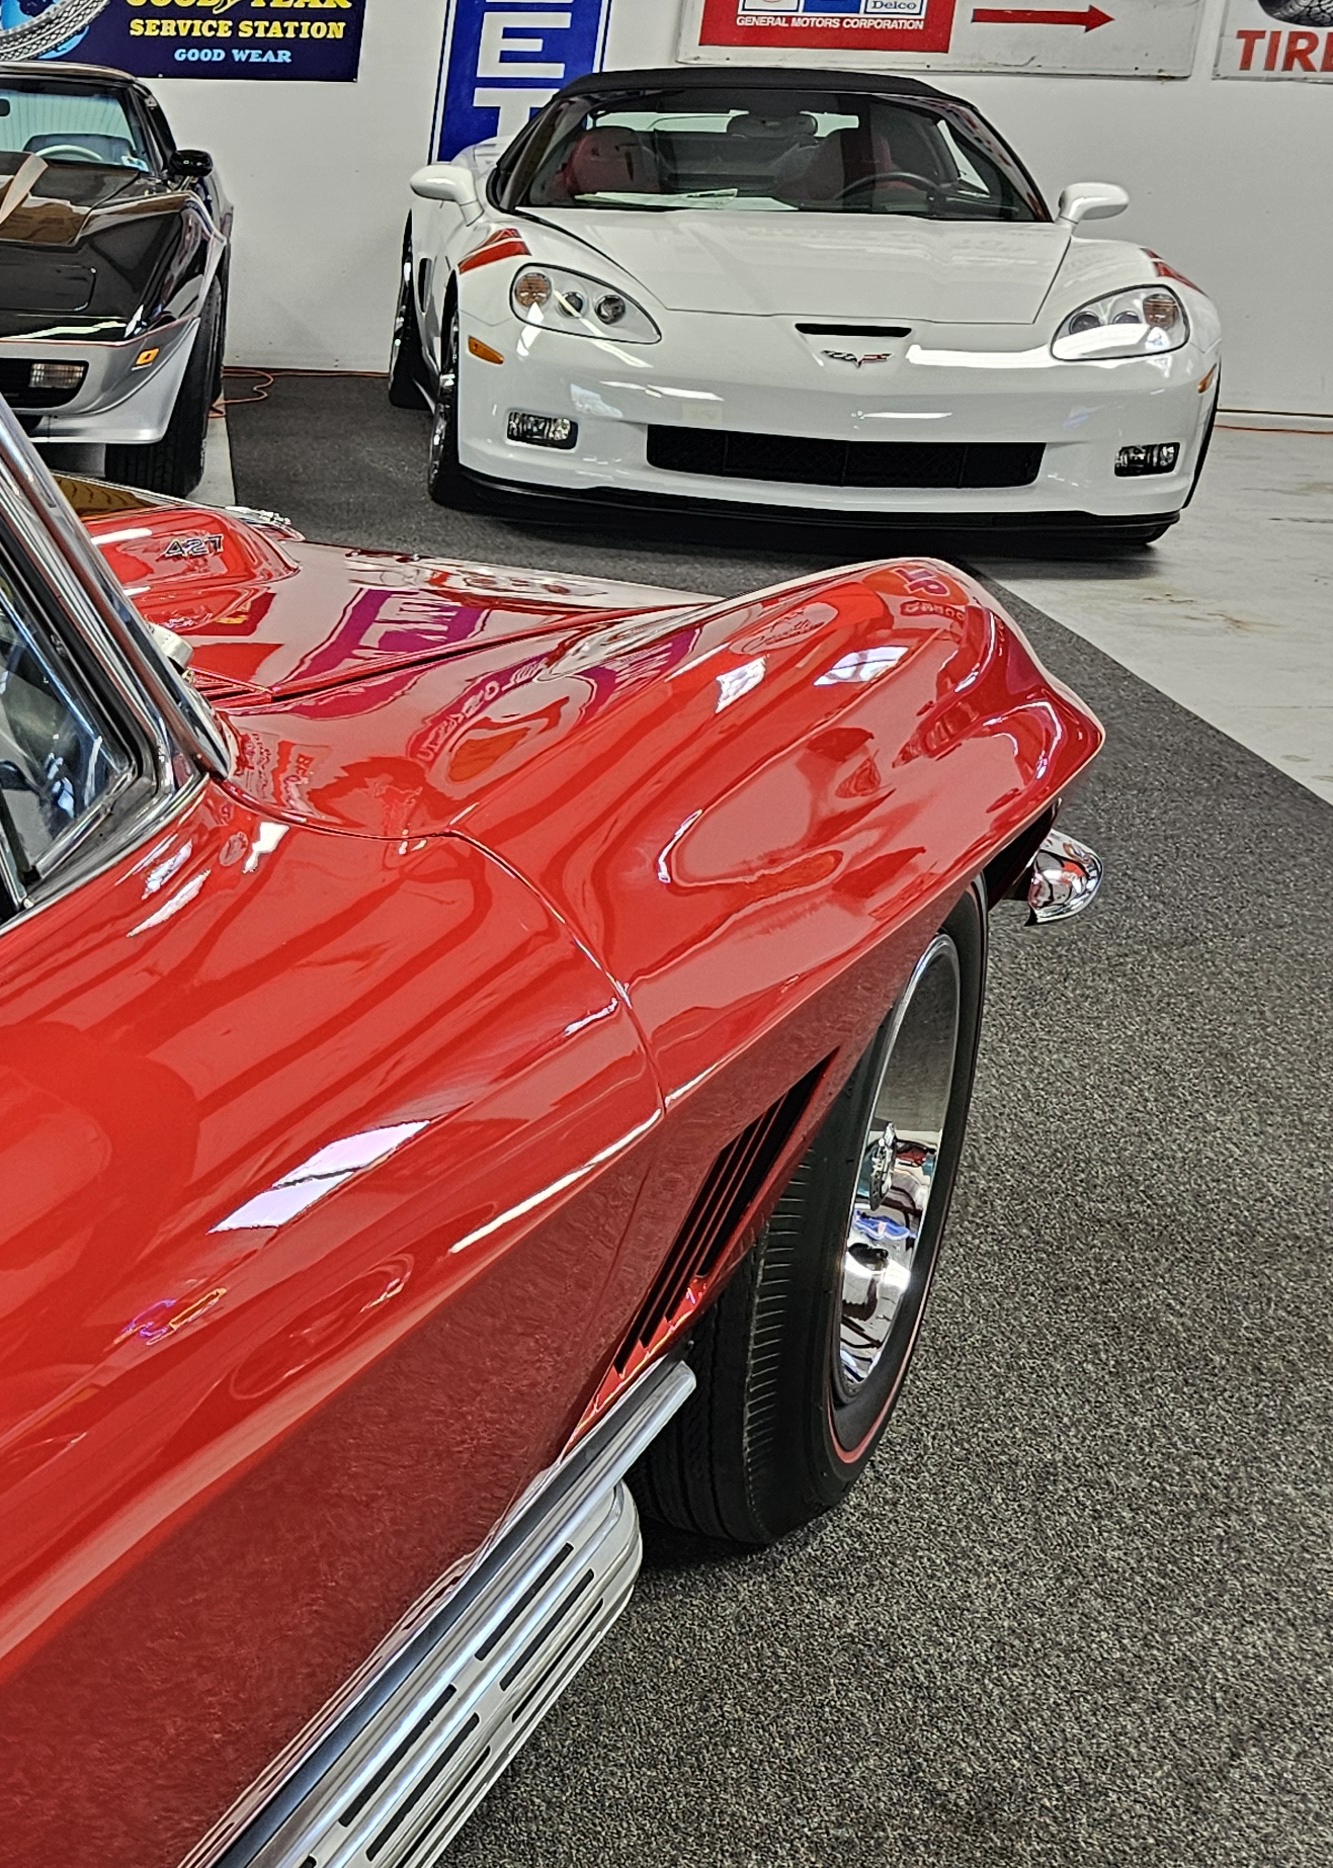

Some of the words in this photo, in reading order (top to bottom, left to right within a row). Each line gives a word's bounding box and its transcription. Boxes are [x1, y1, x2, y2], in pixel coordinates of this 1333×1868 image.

[871, 0, 917, 11] Delco
[129, 18, 232, 38] SERVICE
[237, 20, 346, 39] STATION
[736, 16, 789, 28] GENERAL
[790, 16, 841, 29] MOTORS
[842, 18, 925, 31] CORPORATION
[173, 47, 226, 63] GOOD
[231, 48, 293, 64] WEAR
[164, 533, 224, 558] 427
